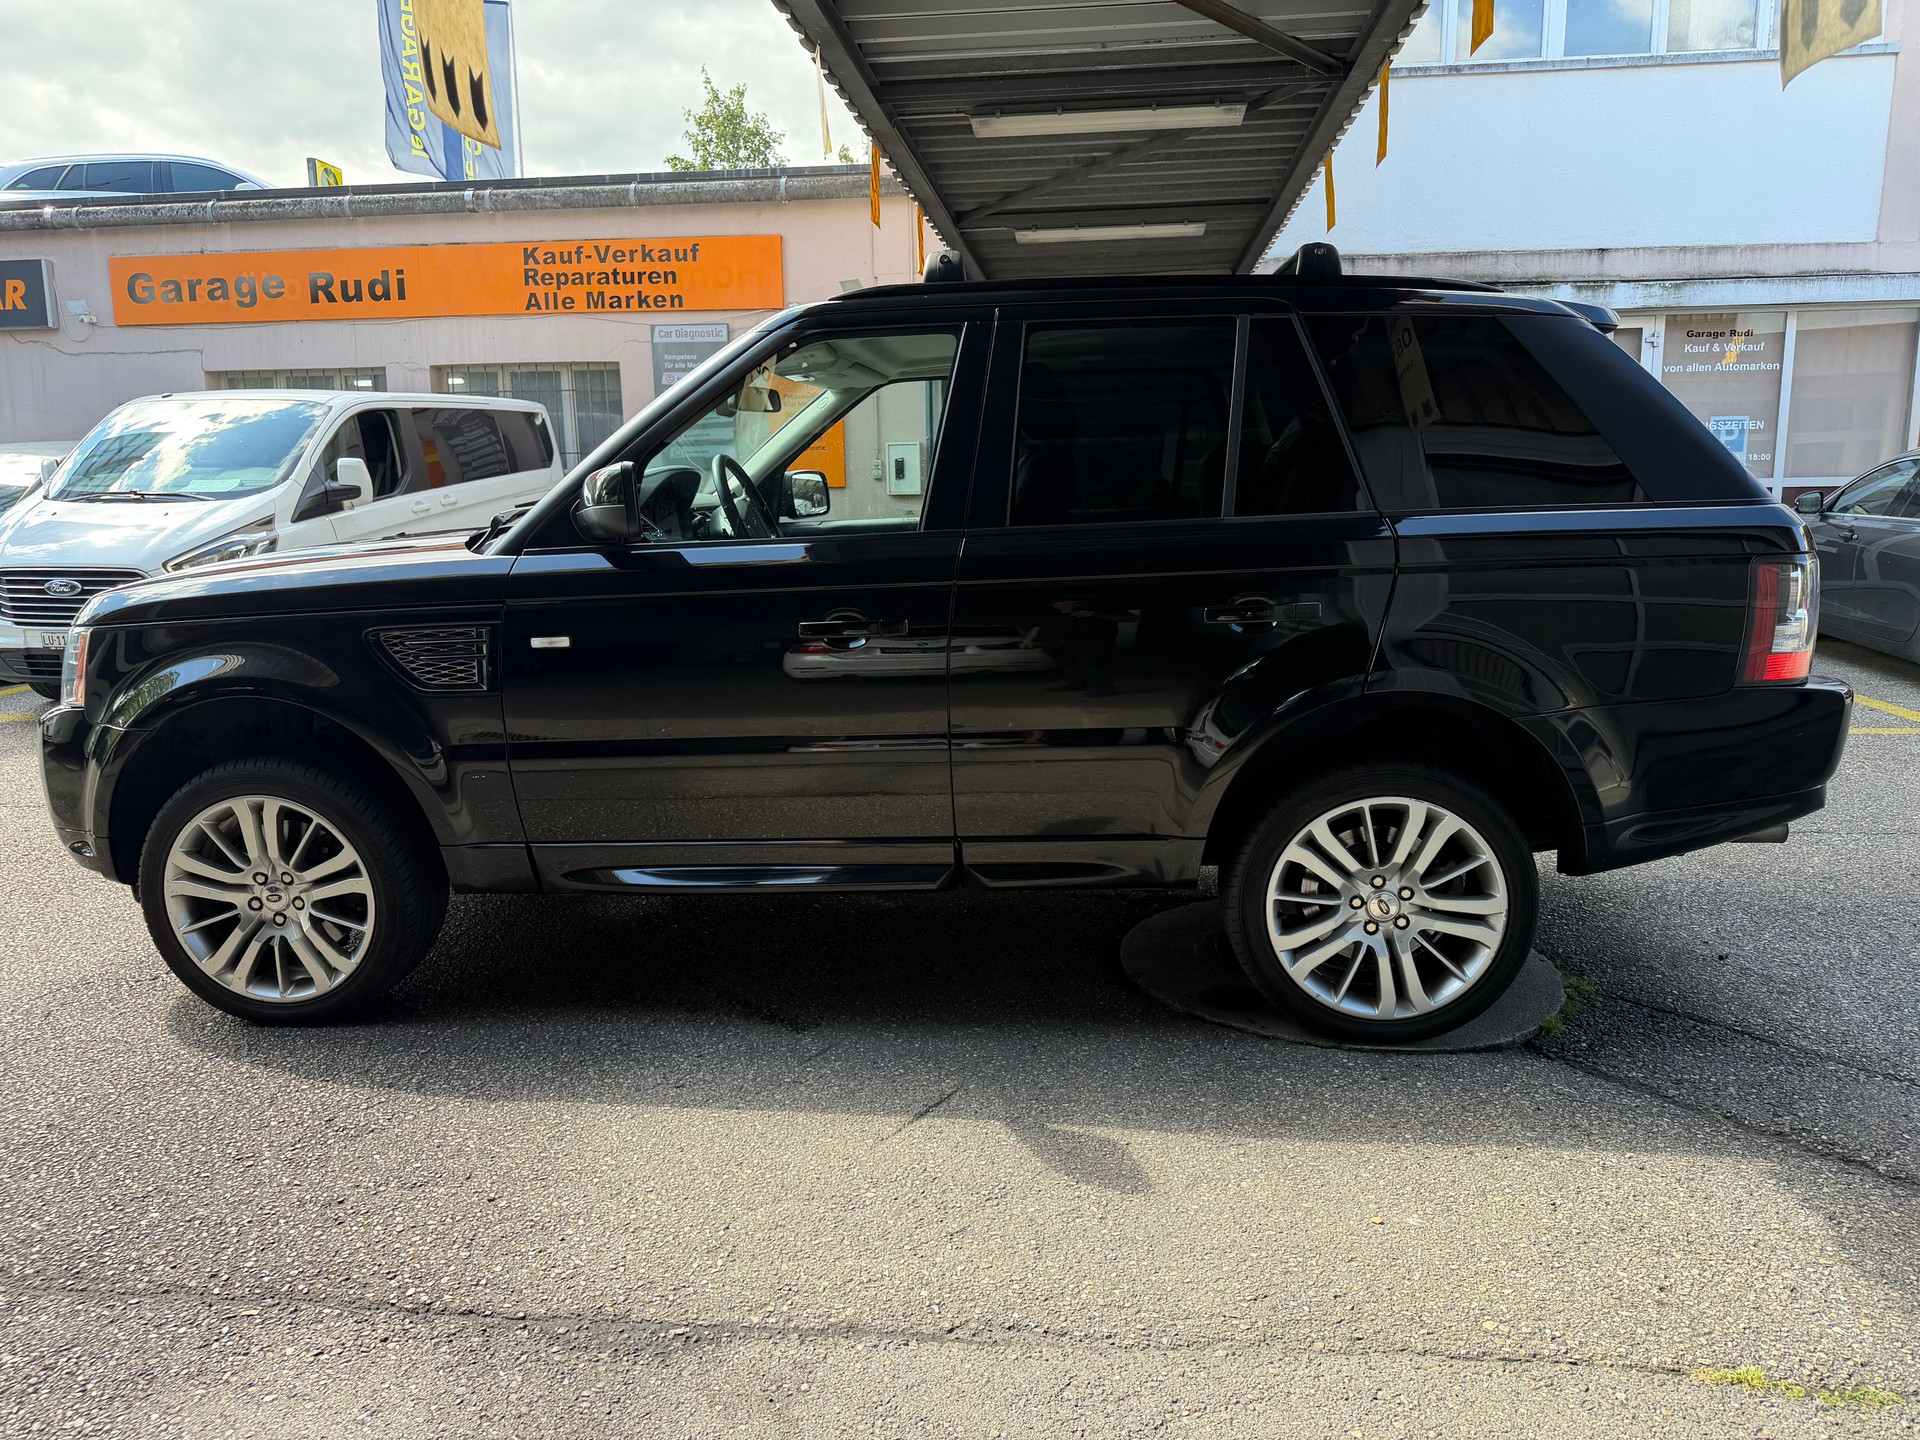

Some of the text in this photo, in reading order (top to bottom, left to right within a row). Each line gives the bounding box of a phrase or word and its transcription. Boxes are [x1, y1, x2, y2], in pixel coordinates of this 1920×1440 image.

[523, 243, 700, 266] Kauf-Verkauf
[523, 267, 677, 290] Reparaturen
[126, 269, 406, 308] Garage Rudi
[525, 291, 683, 311] Alle Marken
[658, 327, 723, 340] Car Diagnostic
[1686, 329, 1754, 339] Garage Rudi
[1684, 342, 1766, 353] Kauf & Verkauf
[1663, 362, 1780, 373] von allen Automarken
[1748, 453, 1771, 461] 18:00
[50, 582, 71, 592] Ford
